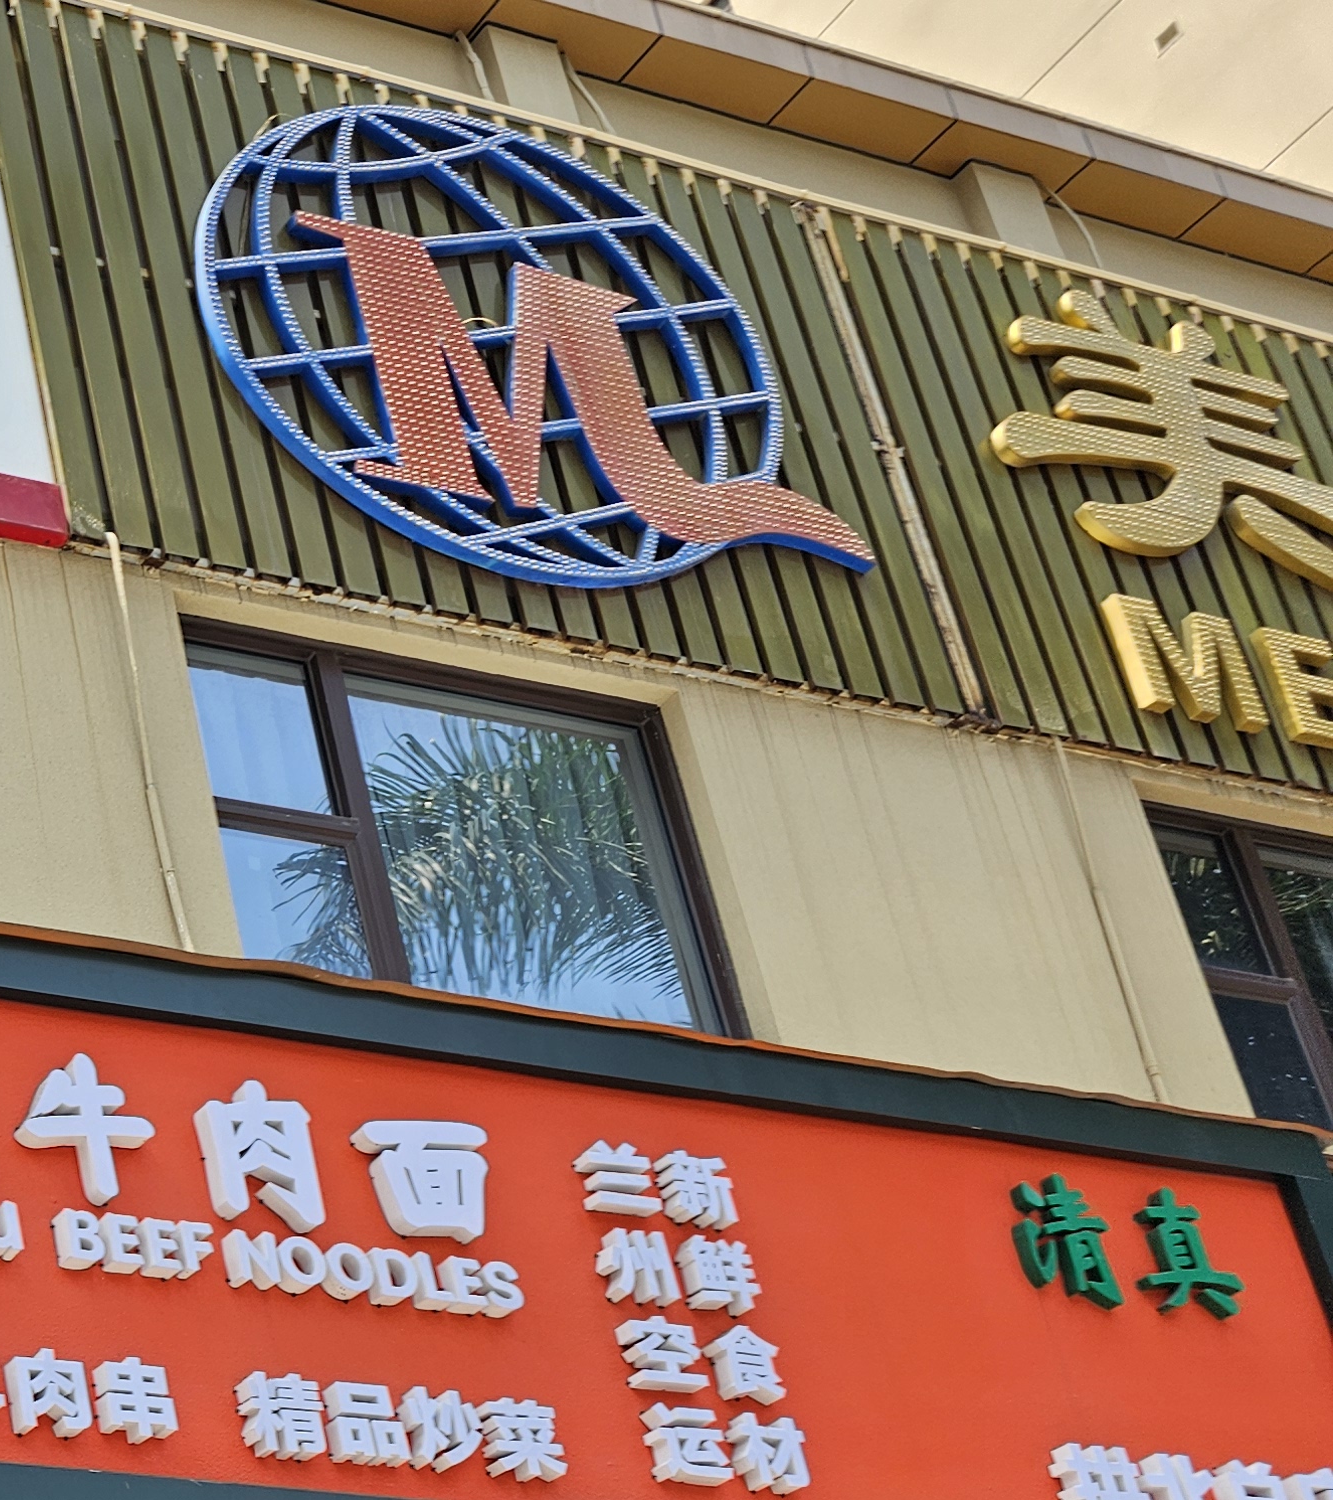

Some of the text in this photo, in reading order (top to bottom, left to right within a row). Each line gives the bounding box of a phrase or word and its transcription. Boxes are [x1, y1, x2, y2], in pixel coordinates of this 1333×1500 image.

[990, 290, 1333, 592] 美
[51, 1208, 215, 1280] BEEF
[221, 1229, 525, 1319] NOODLES
[1010, 1173, 1245, 1320] 清真
[234, 1371, 568, 1483] 精品炒菜
